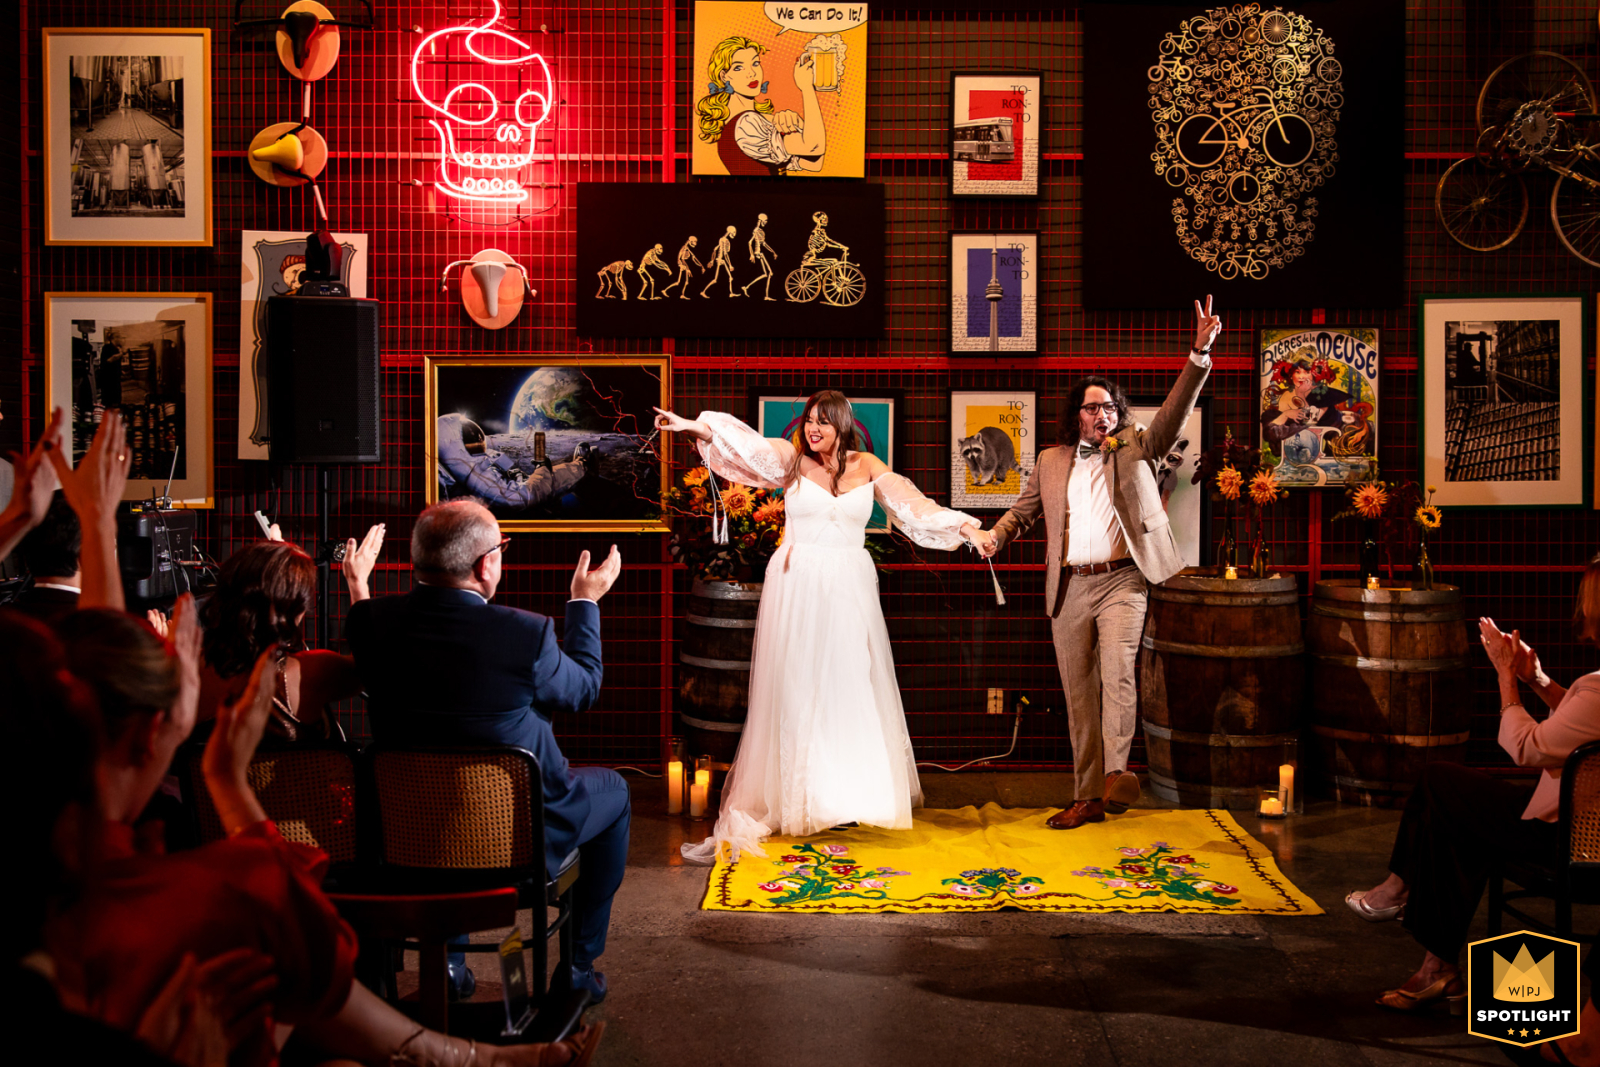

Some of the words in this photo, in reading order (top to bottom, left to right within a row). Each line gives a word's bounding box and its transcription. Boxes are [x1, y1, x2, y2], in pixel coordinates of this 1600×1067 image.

[776, 7, 794, 20] We
[799, 7, 821, 20] Can
[826, 7, 844, 20] Do
[848, 6, 863, 22] It!
[1010, 85, 1032, 96] TO-
[1001, 99, 1032, 109] RON-
[1013, 112, 1031, 123] TO
[1008, 243, 1030, 253] TO-
[1000, 256, 1030, 267] RON-
[1011, 270, 1029, 280] TO
[1316, 331, 1377, 379] MEUSE
[1007, 400, 1029, 411] TO-
[998, 414, 1029, 424] RON-
[1010, 427, 1028, 438] TO
